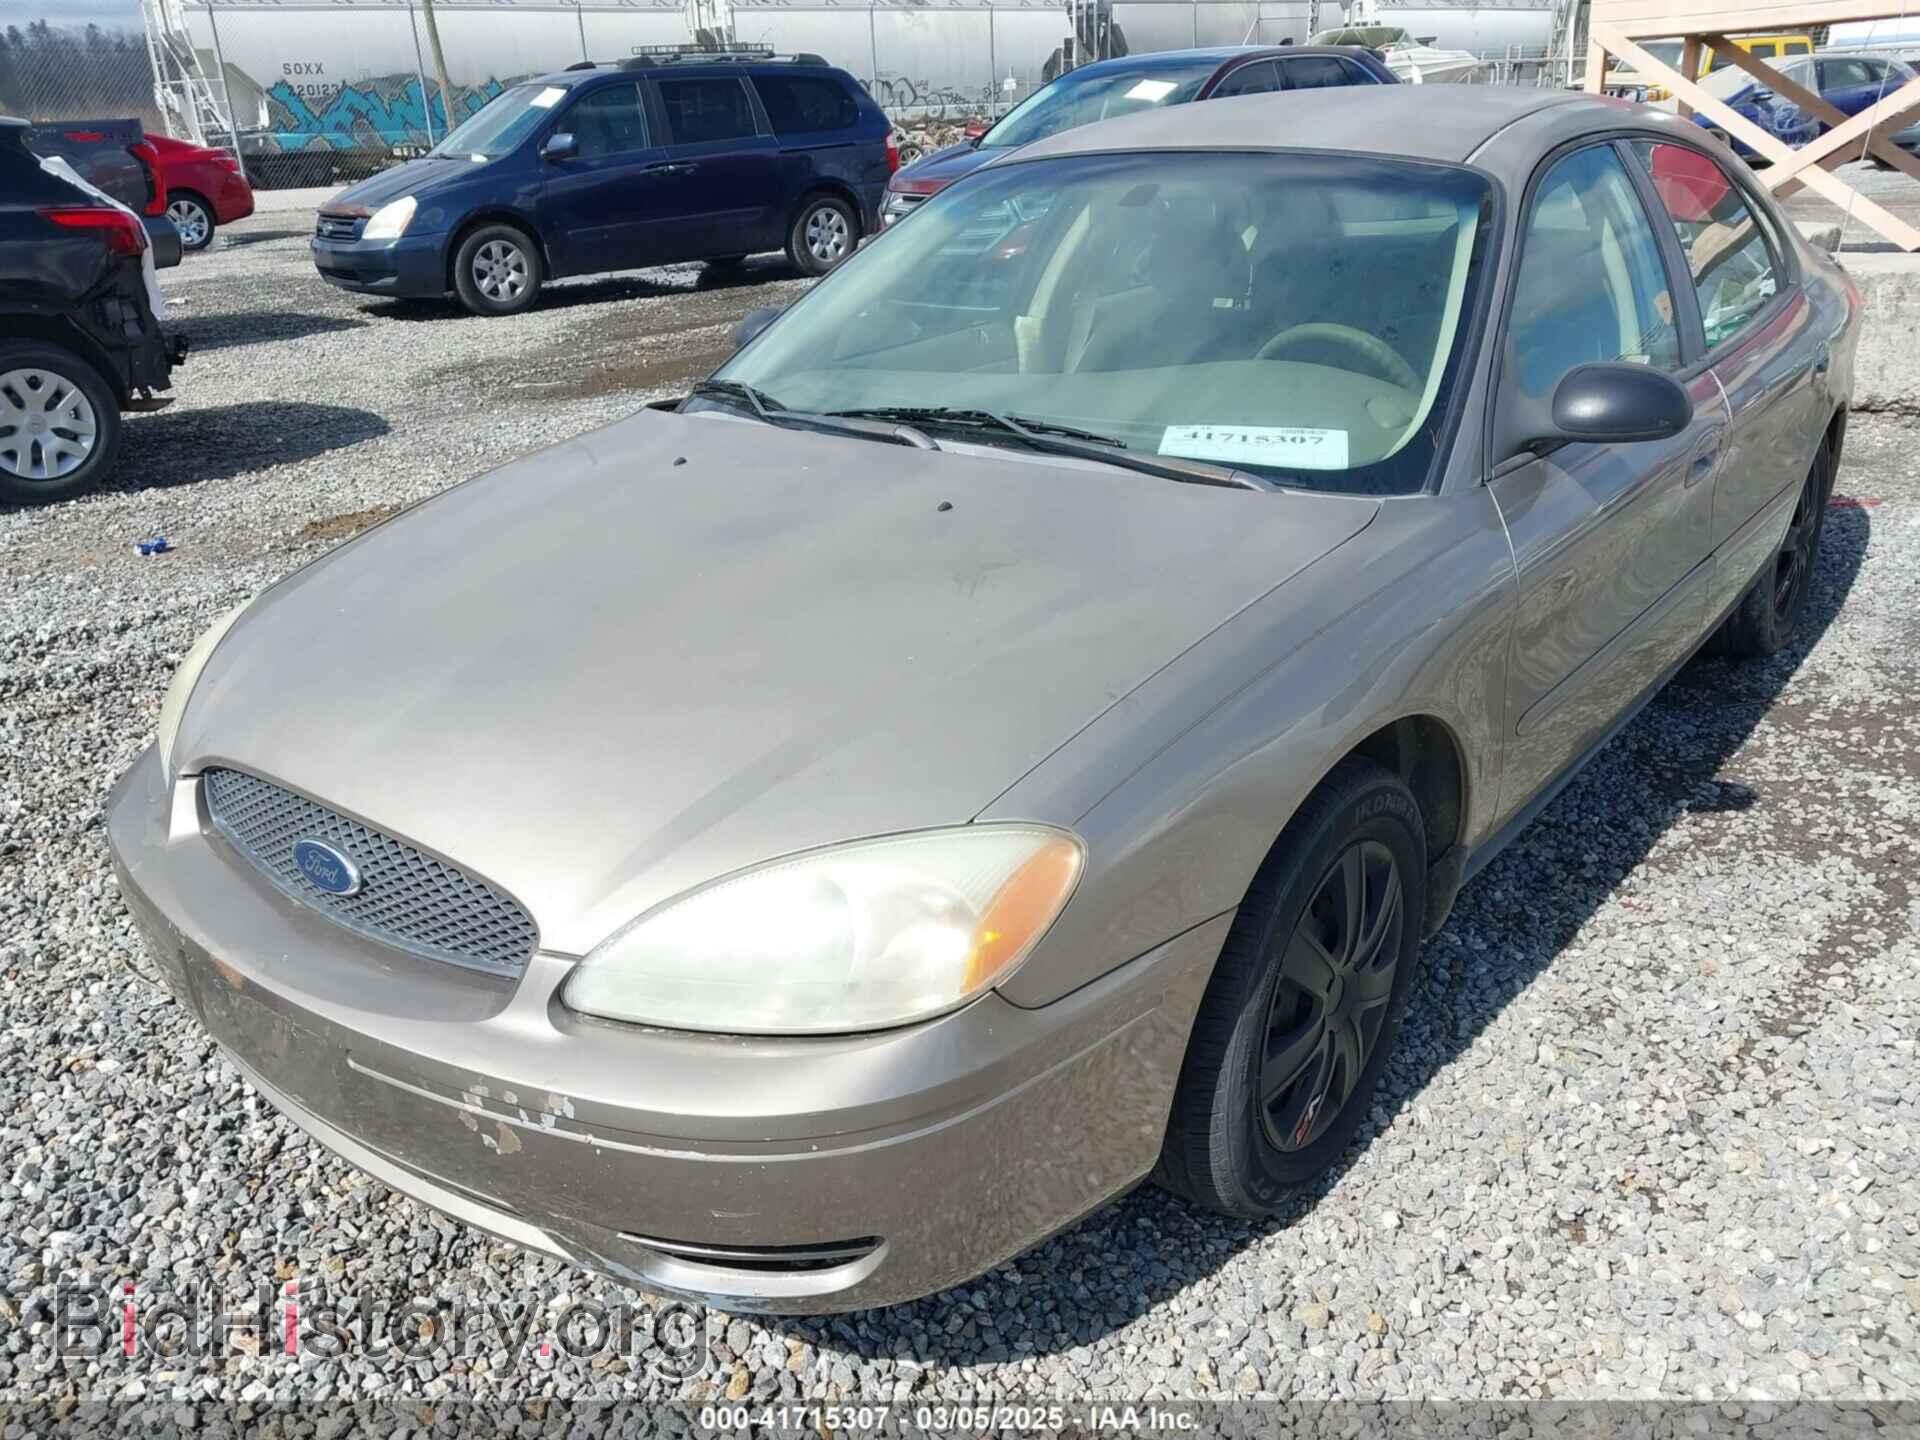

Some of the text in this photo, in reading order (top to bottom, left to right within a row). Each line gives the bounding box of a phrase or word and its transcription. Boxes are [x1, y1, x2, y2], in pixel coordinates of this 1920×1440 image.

[282, 62, 325, 76] SOXX
[1183, 431, 1324, 445] 41715307
[305, 849, 340, 885] Ford
